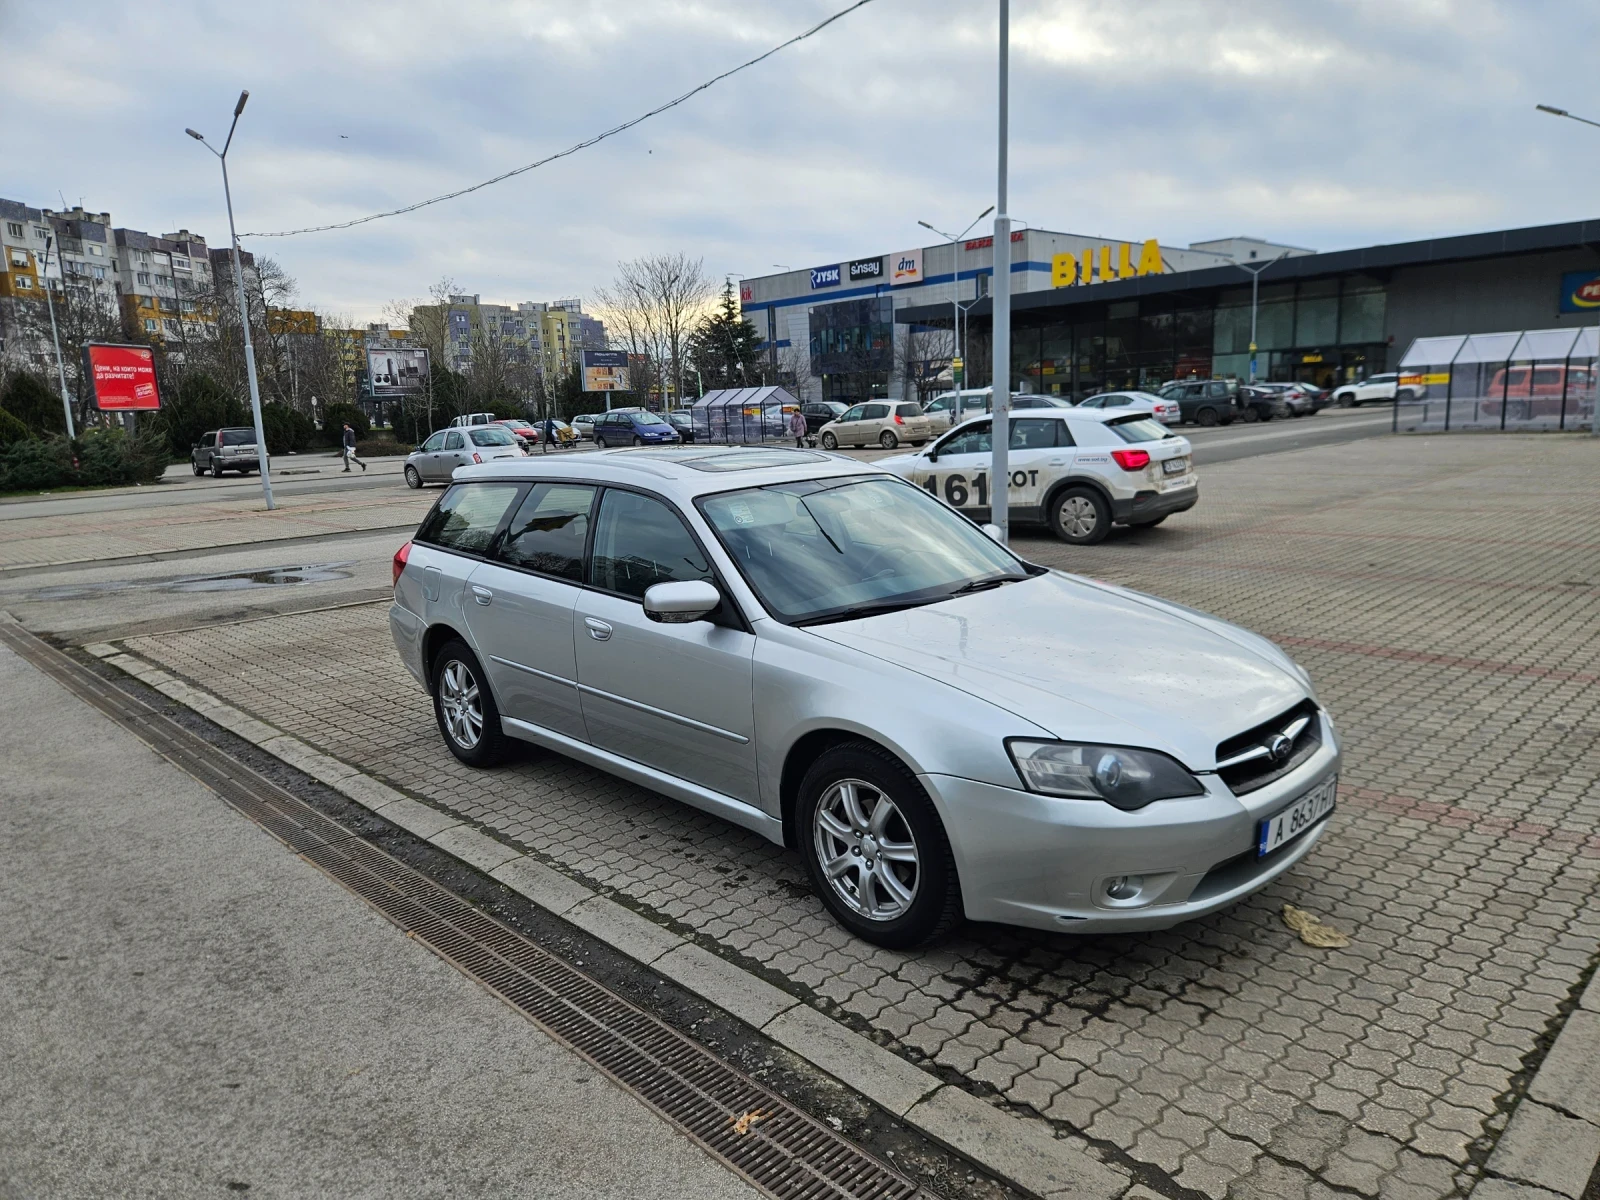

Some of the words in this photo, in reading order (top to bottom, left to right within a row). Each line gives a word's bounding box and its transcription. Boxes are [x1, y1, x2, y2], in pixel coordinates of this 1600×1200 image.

[850, 261, 880, 275] sinsay
[898, 257, 915, 271] dm
[1051, 238, 1164, 288] BILLA
[816, 268, 839, 283] JYSK
[741, 286, 752, 301] kik
[1007, 469, 1039, 488] ОТ
[922, 472, 988, 507] 161
[1274, 817, 1284, 845] A
